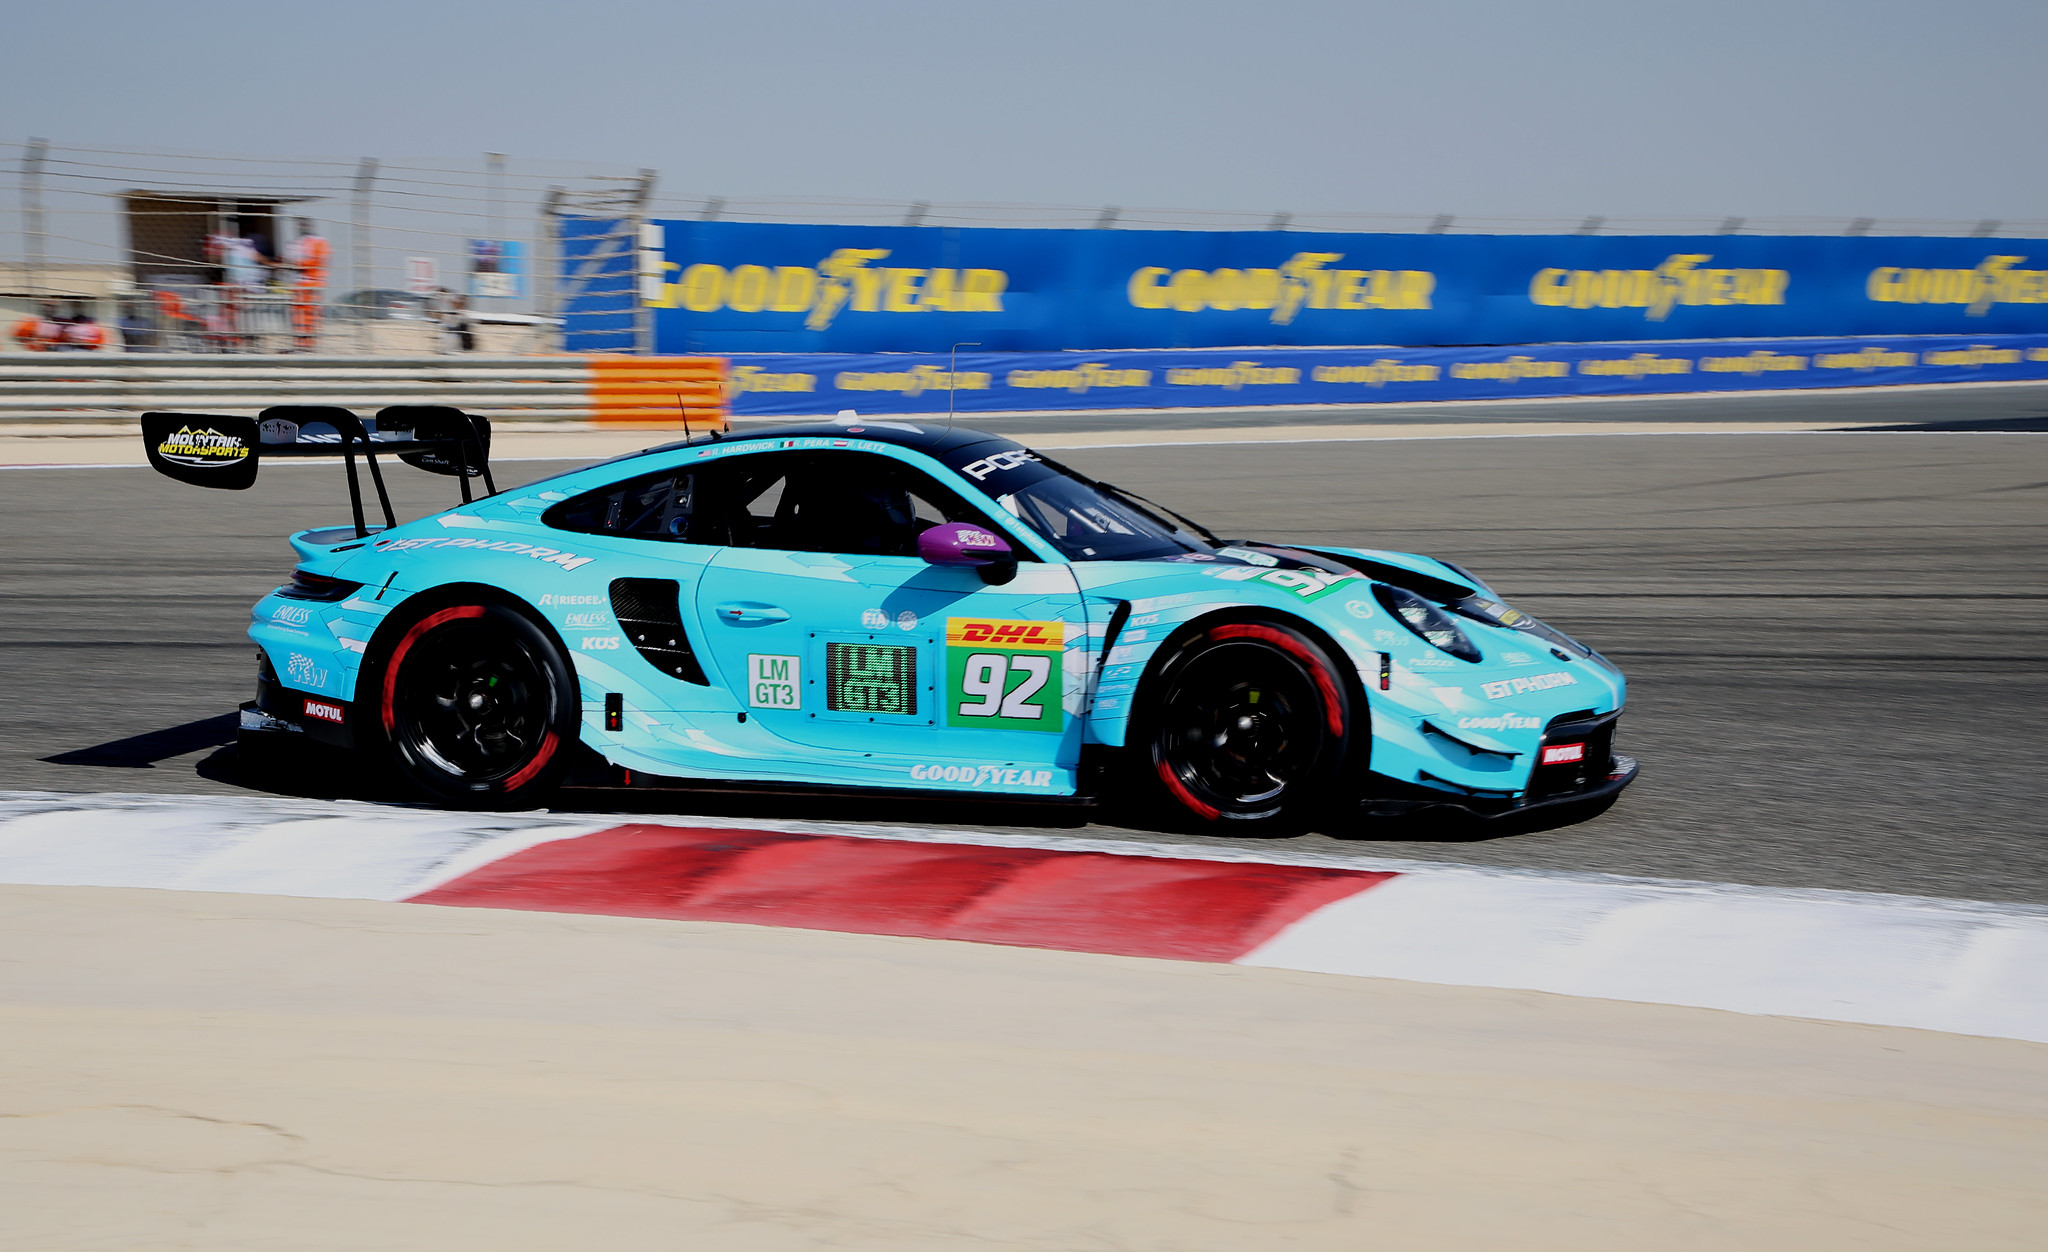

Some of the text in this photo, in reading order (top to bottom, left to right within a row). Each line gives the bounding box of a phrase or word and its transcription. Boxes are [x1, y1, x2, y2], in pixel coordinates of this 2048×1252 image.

[722, 441, 775, 454] HARDWICK
[804, 439, 830, 448] PERA
[857, 441, 887, 453] LIETZ
[272, 605, 313, 624] ENDLESS
[564, 611, 609, 625] ENDLESS
[962, 624, 1049, 645] DHL
[759, 658, 789, 681] LM
[755, 682, 794, 706] GT3
[843, 679, 900, 712] GT3
[958, 653, 1052, 721] 92
[305, 701, 342, 721] MOTUL
[910, 764, 1052, 788] GOODYEAR
